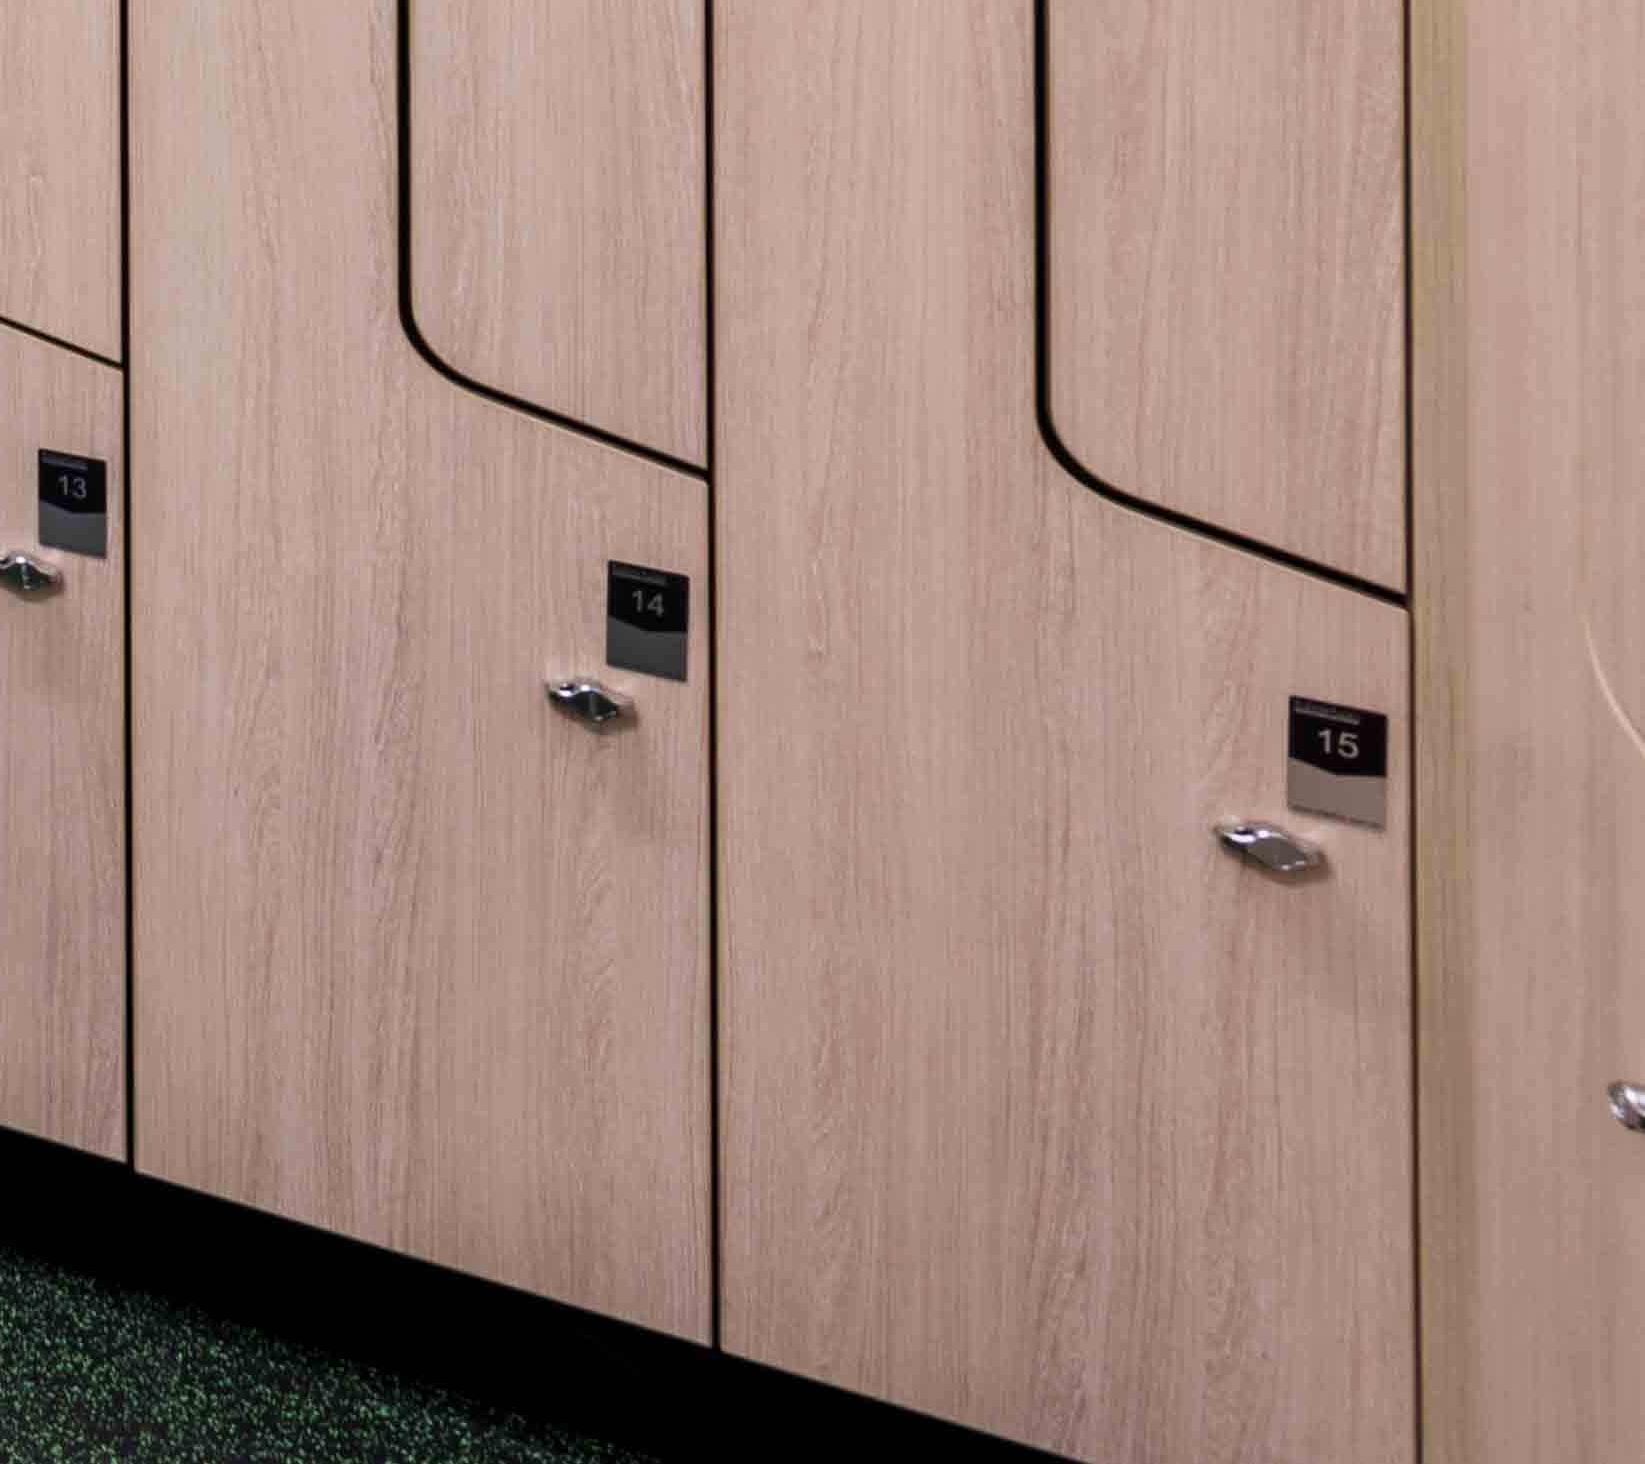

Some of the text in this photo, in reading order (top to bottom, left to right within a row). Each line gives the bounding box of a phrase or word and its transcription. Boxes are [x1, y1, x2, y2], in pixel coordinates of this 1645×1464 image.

[58, 475, 87, 499] 13
[632, 589, 664, 618] 14
[1317, 728, 1360, 759] 15
